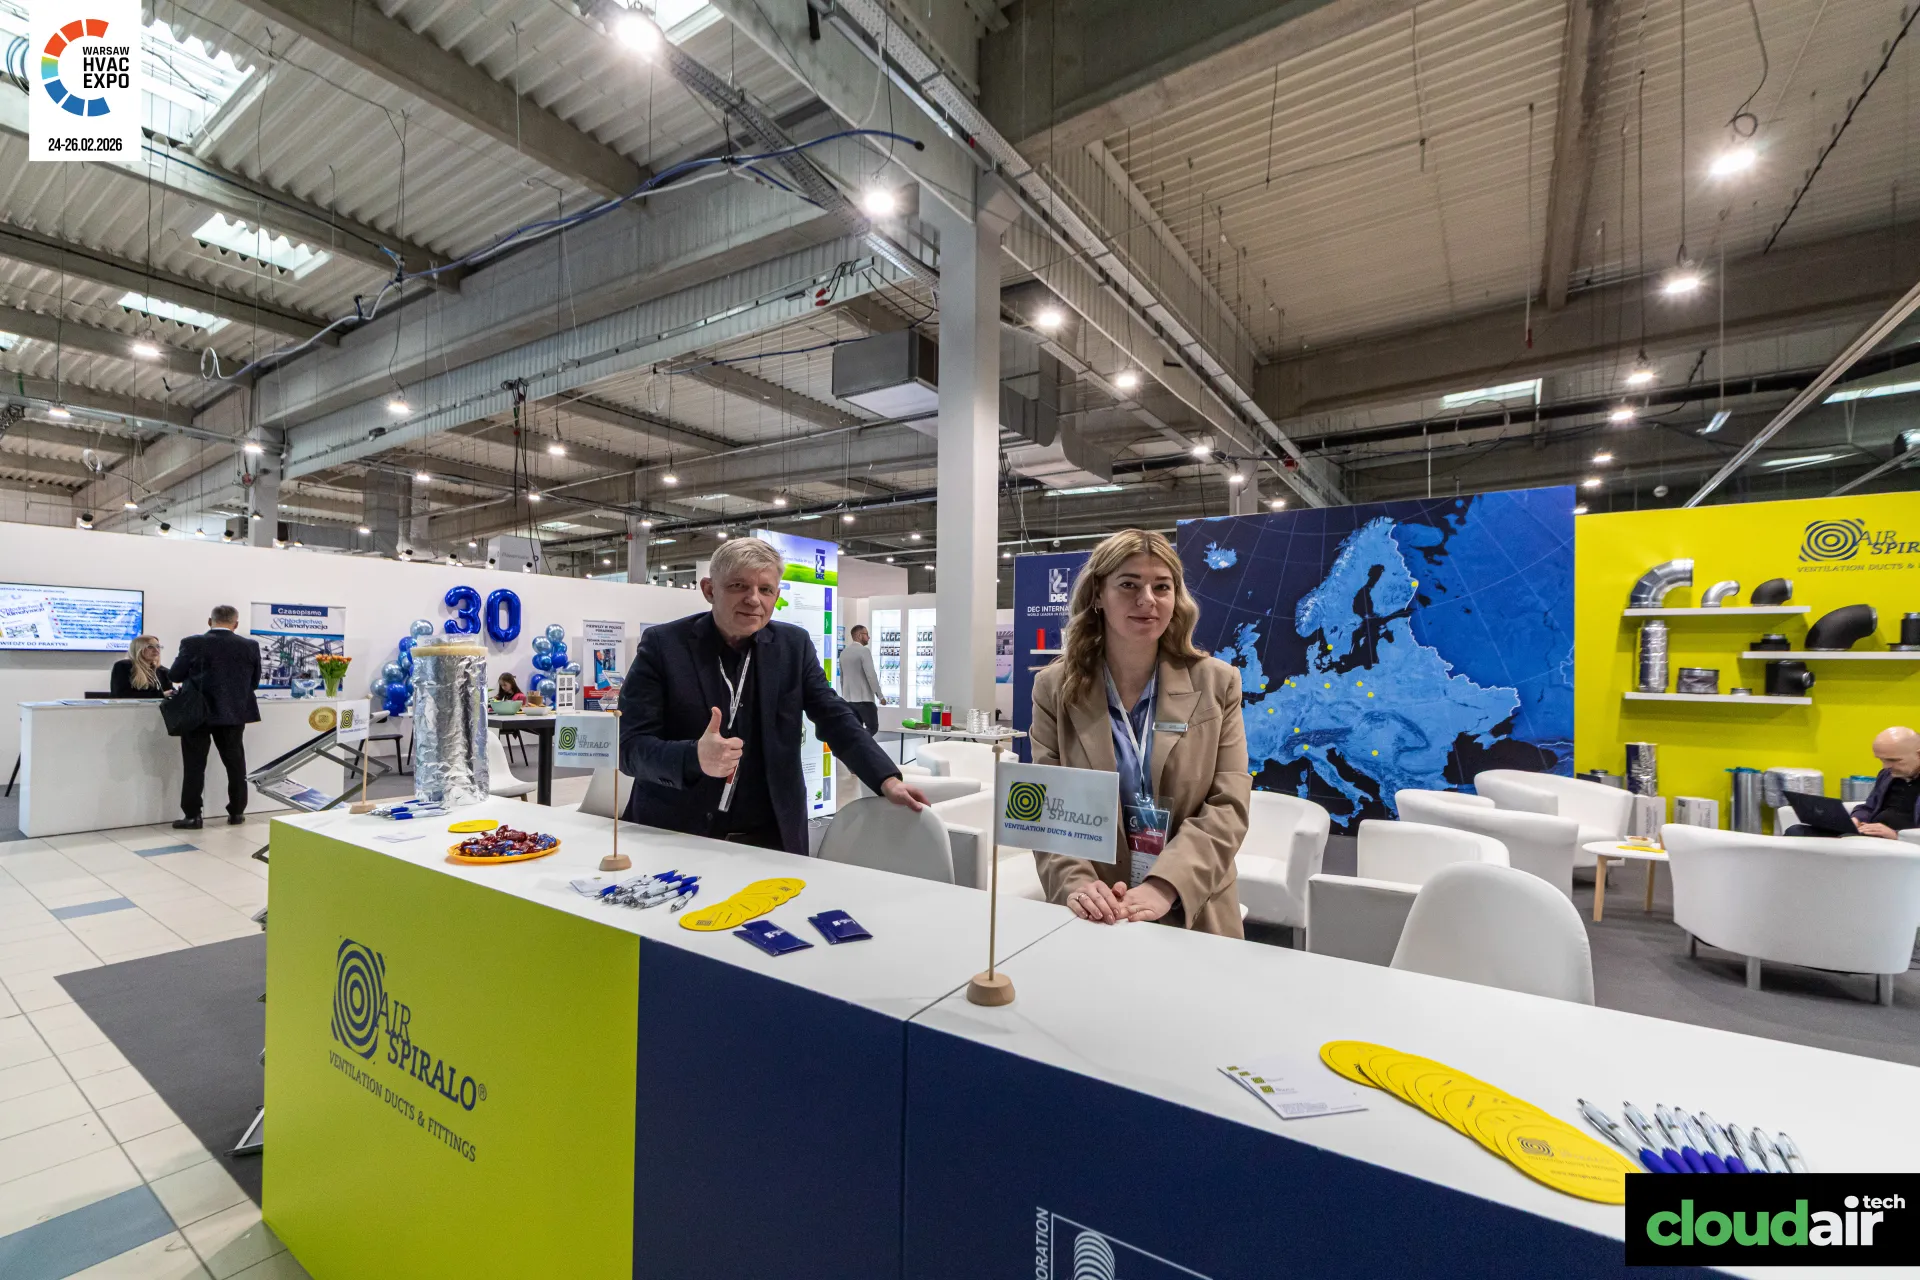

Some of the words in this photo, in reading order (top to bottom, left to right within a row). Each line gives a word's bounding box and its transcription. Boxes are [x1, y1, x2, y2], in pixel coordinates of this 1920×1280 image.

[1856, 530, 1897, 546] AIR
[1796, 564, 1865, 573] VENTILATION
[1868, 562, 1904, 571] DUCTS
[1050, 593, 1068, 603] DEC
[277, 608, 322, 617] Czasopismo
[444, 585, 522, 643] 30
[284, 623, 328, 631] Klimatyzacja
[1042, 796, 1065, 812] AIR
[1004, 822, 1046, 833] VENTILATION
[1047, 827, 1067, 836] DUCTS
[1073, 831, 1103, 842] FITTINGS
[376, 991, 412, 1043] AIR
[328, 1050, 383, 1100] VENTILATION
[384, 1087, 415, 1121] DUCTS
[417, 1110, 425, 1129] &
[427, 1116, 476, 1163] FITTINGS
